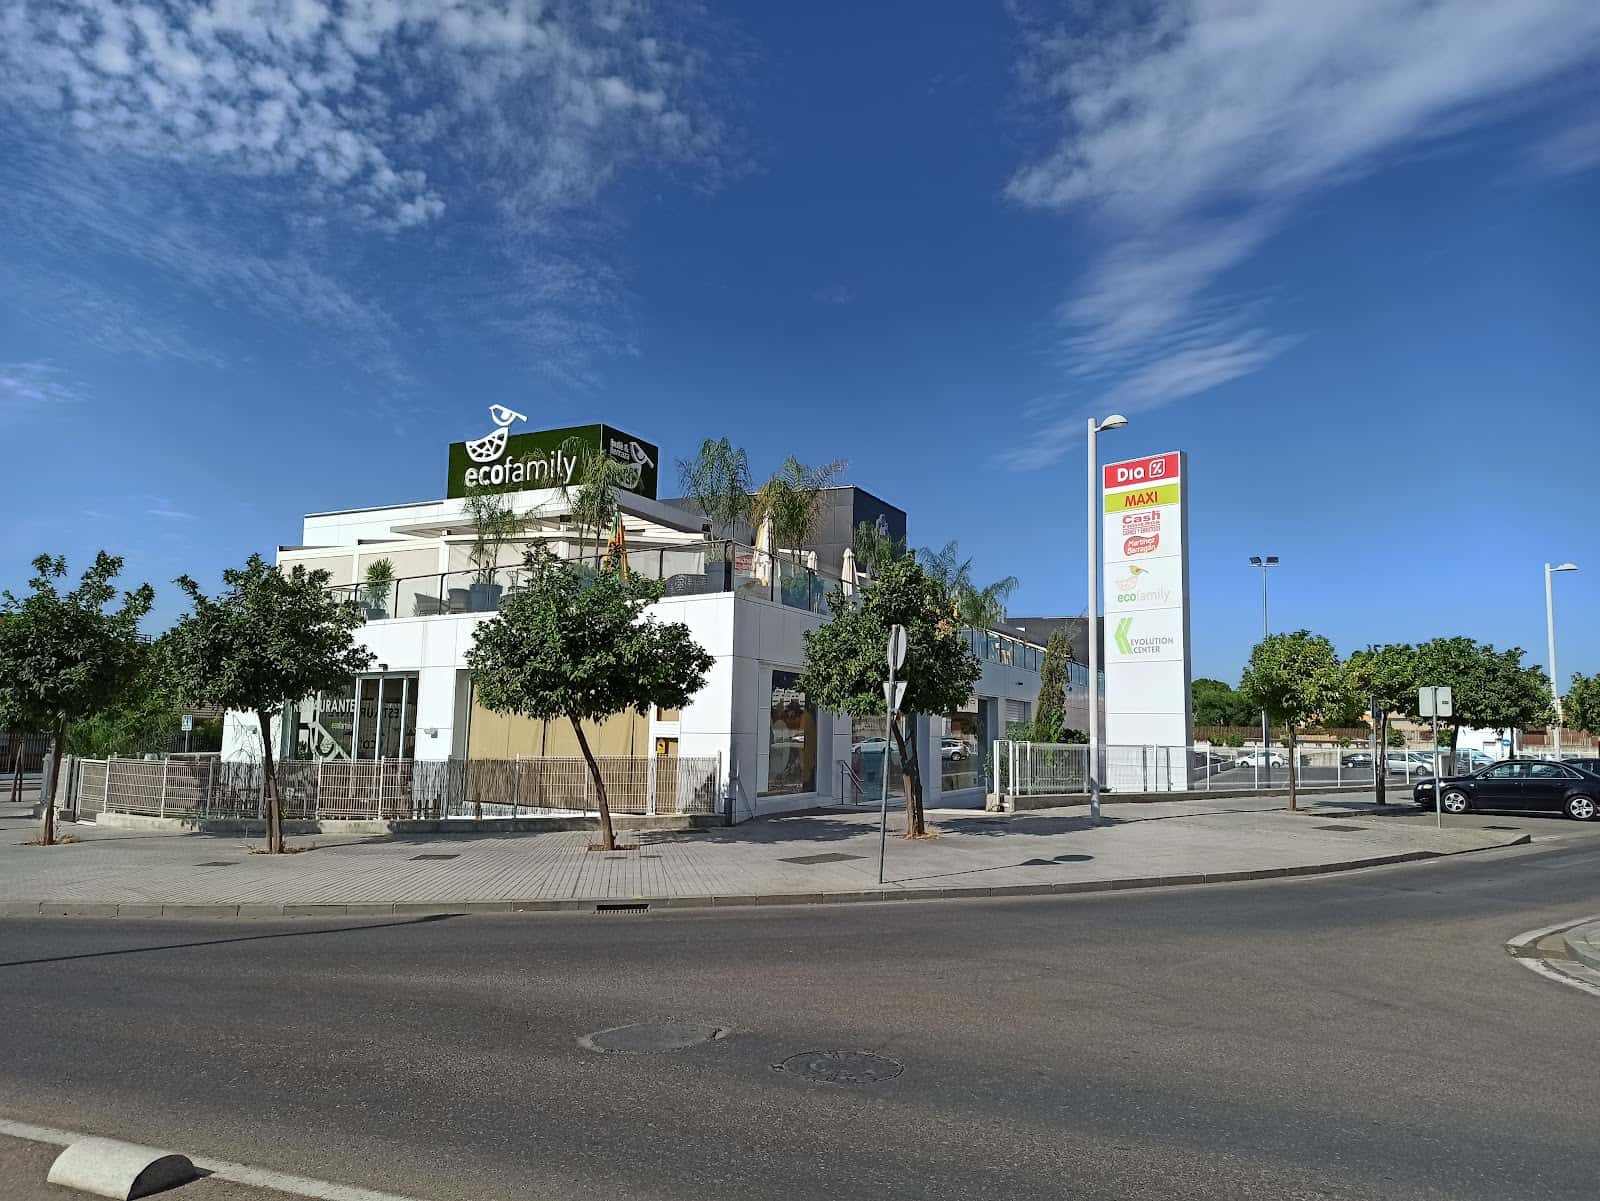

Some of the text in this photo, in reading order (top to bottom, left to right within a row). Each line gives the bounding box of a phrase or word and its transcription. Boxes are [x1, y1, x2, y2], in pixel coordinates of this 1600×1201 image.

[465, 449, 577, 488] ecofamily
[1125, 491, 1158, 507] MAXI
[1122, 510, 1161, 525] Cash
[1117, 583, 1170, 602] ecofamily
[1130, 636, 1174, 647] EVOLUTION
[1133, 646, 1161, 655] CENTER
